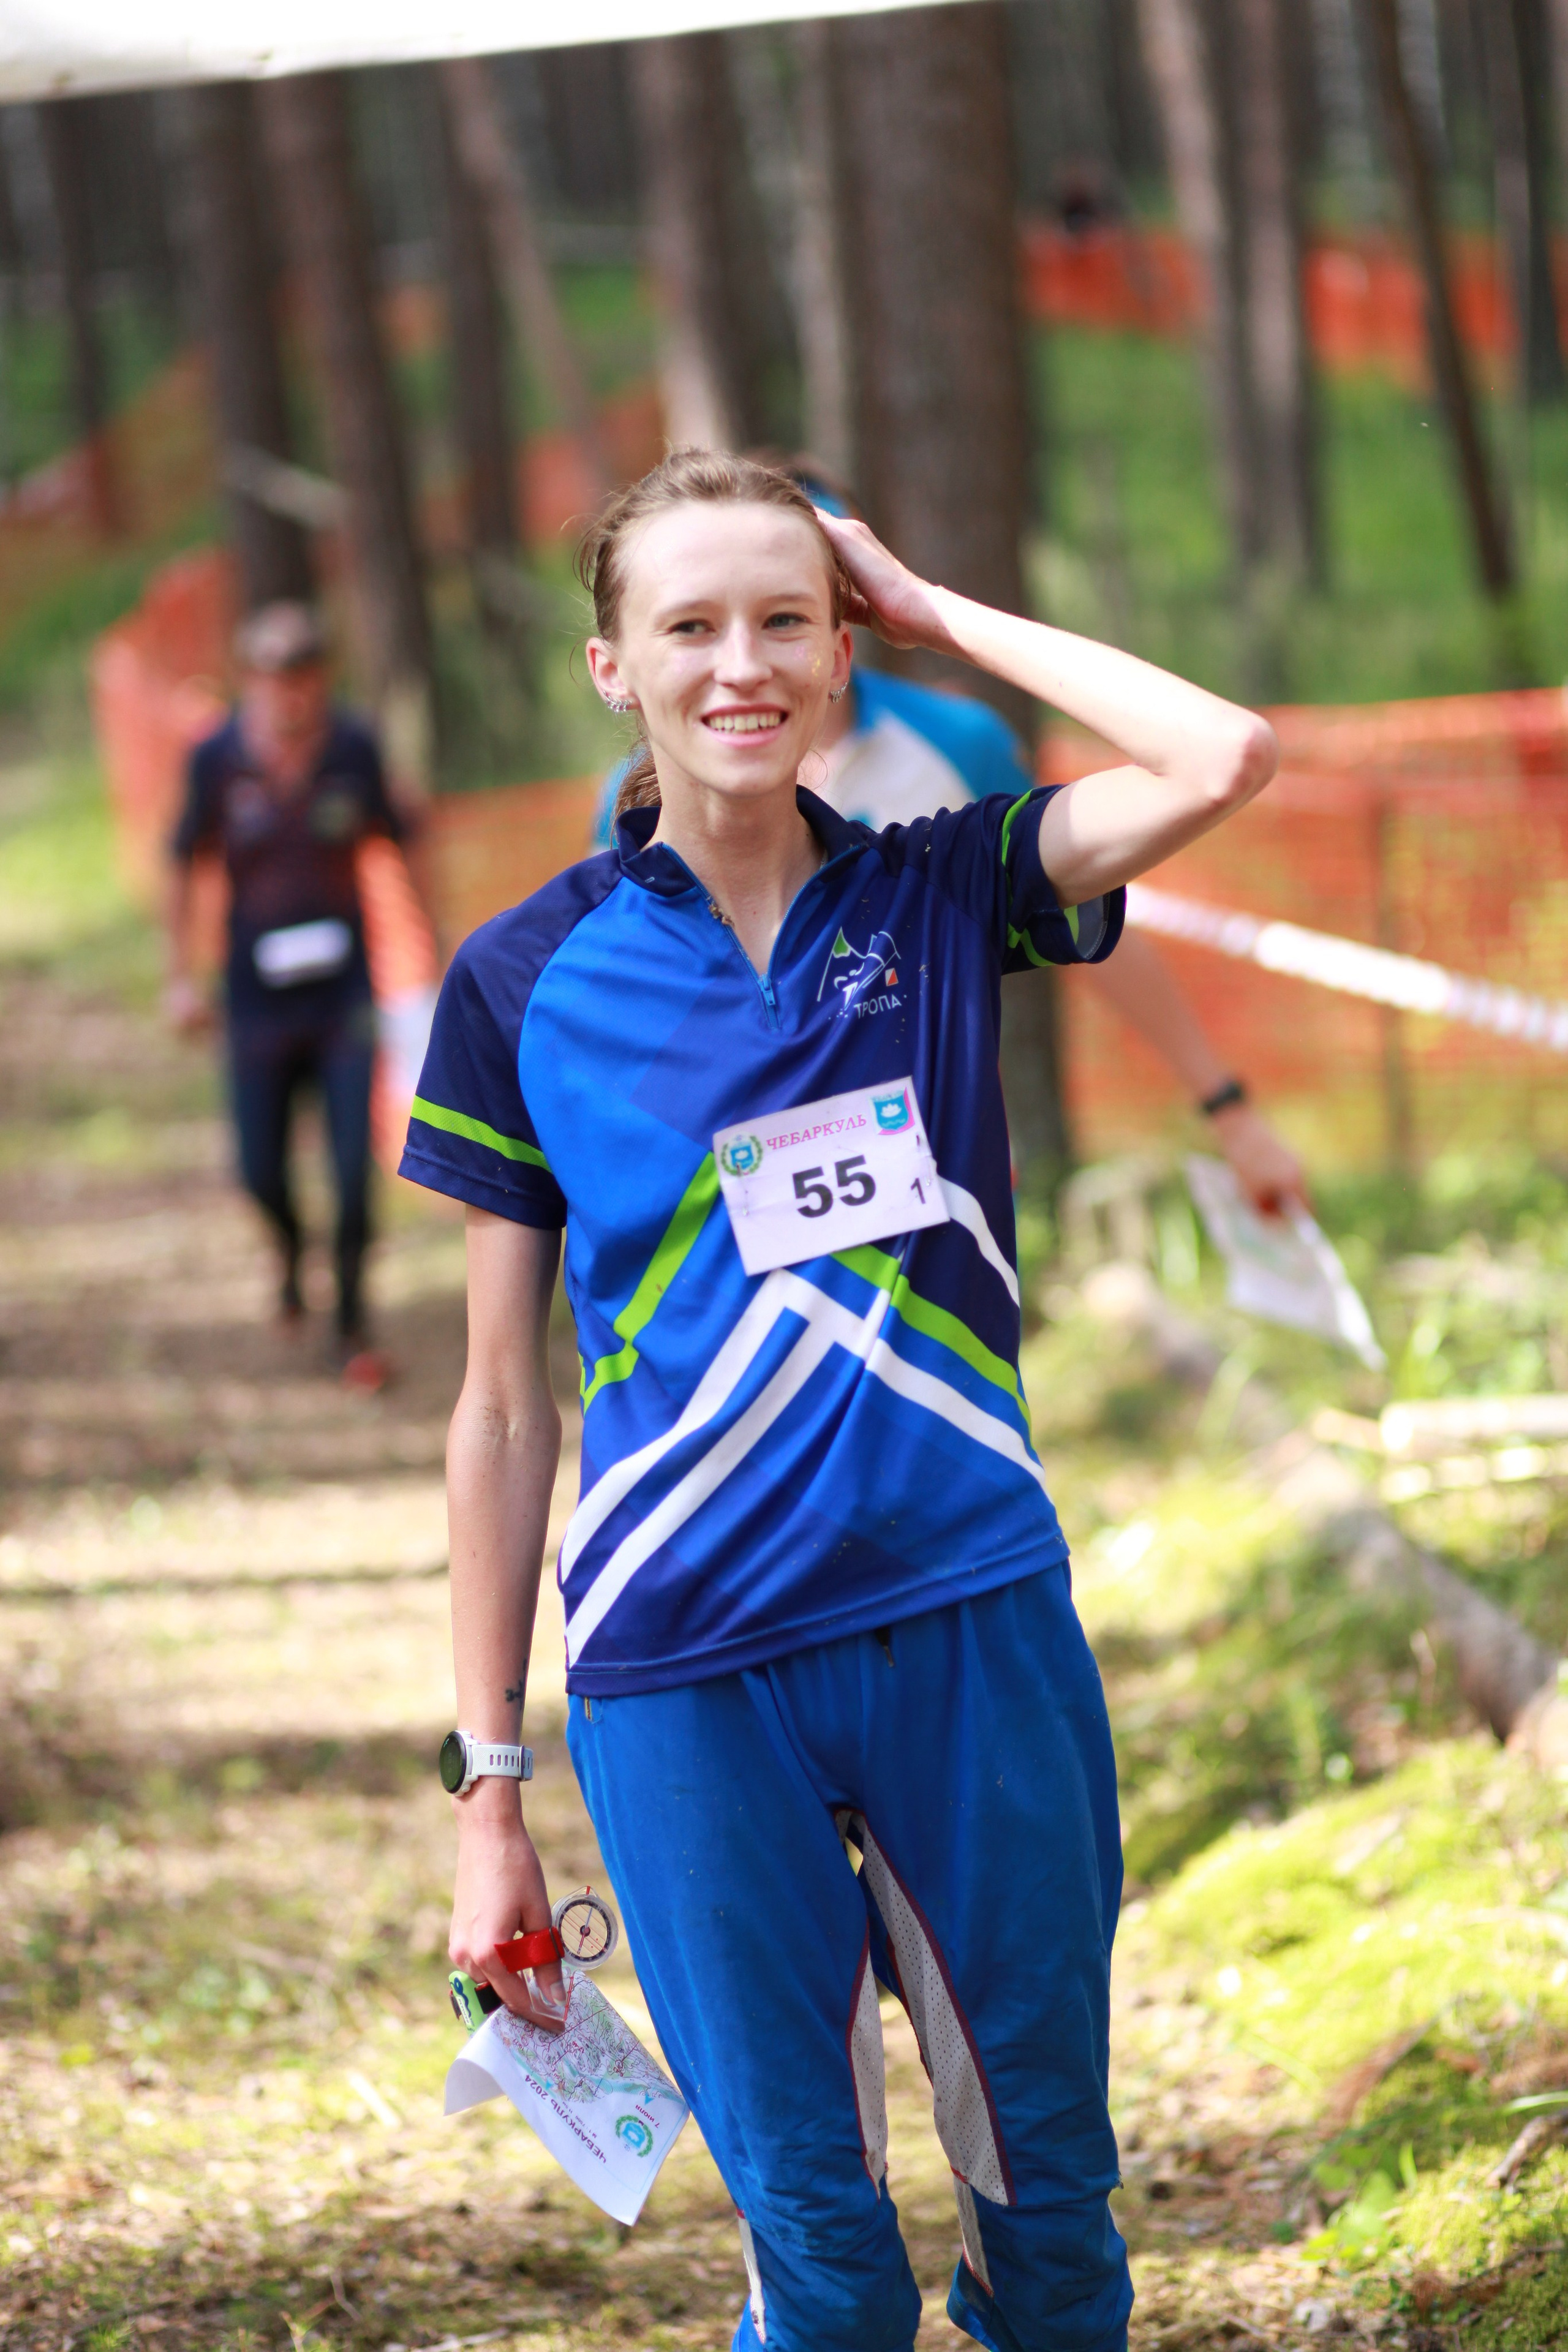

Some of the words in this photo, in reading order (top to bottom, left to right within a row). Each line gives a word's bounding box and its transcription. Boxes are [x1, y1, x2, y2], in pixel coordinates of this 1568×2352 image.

[853, 993, 902, 1019] ТРОПА
[766, 1114, 867, 1151] ЧЕБАРКУЛЬ
[792, 1154, 876, 1218] 55
[910, 1177, 926, 1205] 1
[525, 2074, 549, 2100] 2024
[635, 2105, 655, 2122] июля
[551, 2098, 606, 2163] ЧЕБАРКУЛЬ
